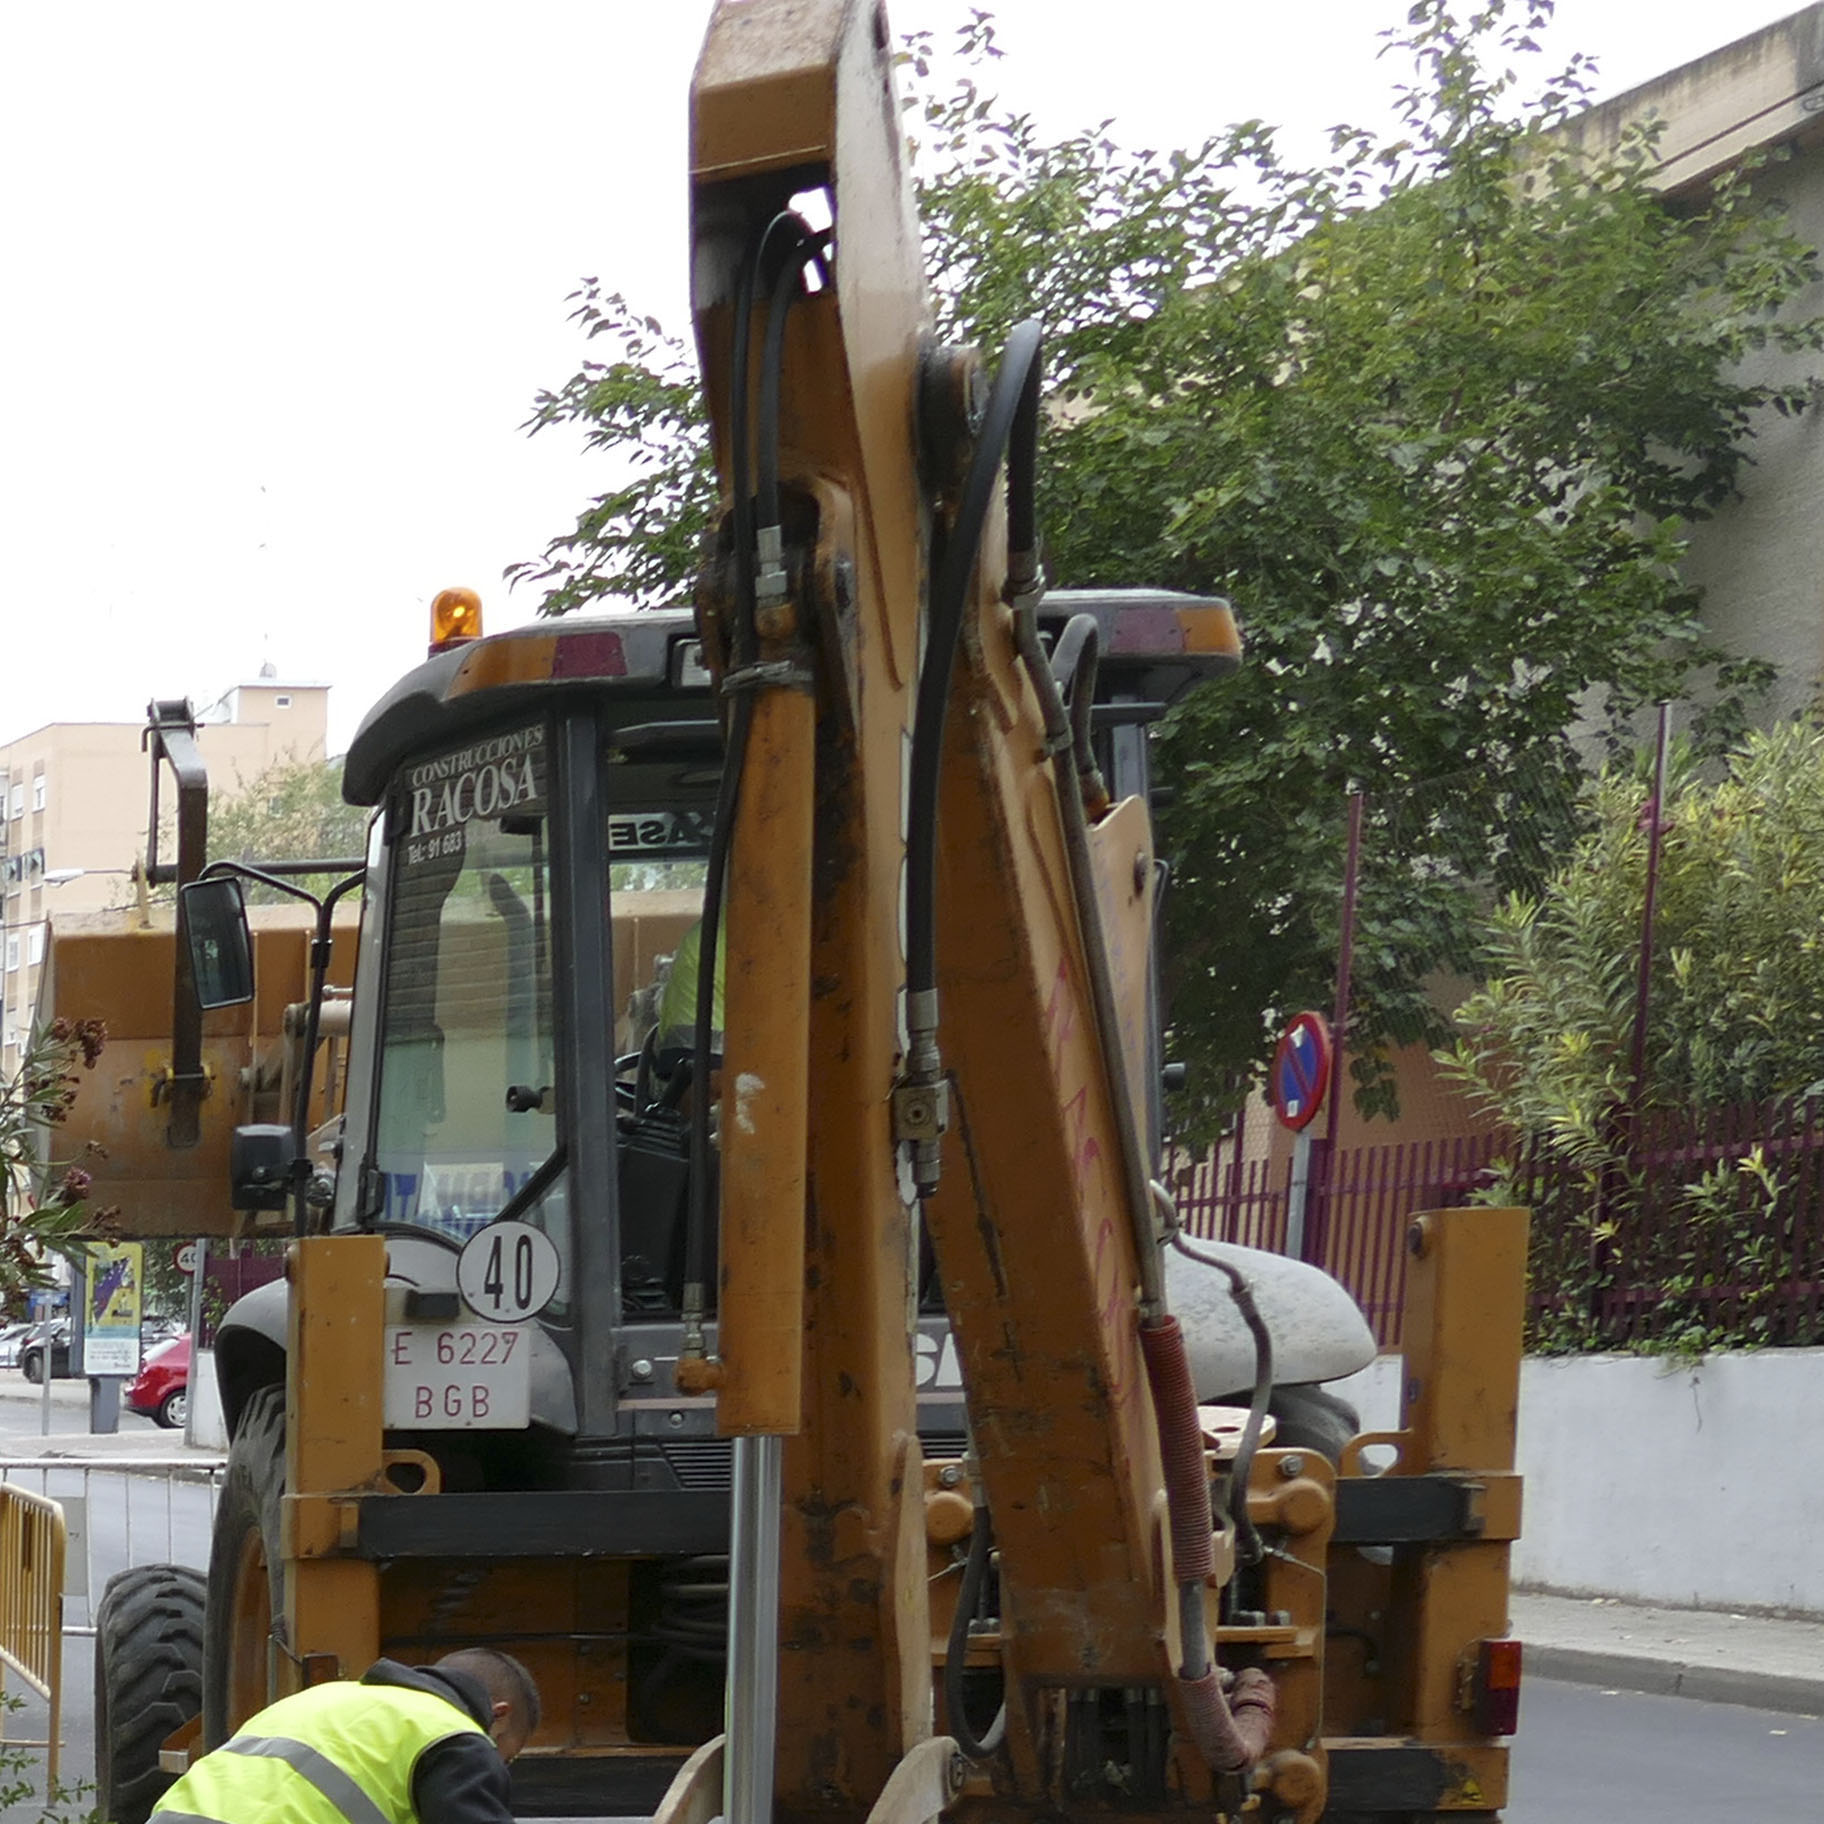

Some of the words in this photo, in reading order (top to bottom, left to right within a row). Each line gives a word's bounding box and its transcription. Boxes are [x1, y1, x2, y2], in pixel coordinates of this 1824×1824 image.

[412, 724, 545, 786] CONSTRUCCIONES
[410, 754, 538, 837] RACOSA
[484, 1235, 533, 1310] 40
[393, 1331, 413, 1366] E
[437, 1331, 520, 1365] 6227
[415, 1384, 490, 1419] BGB
